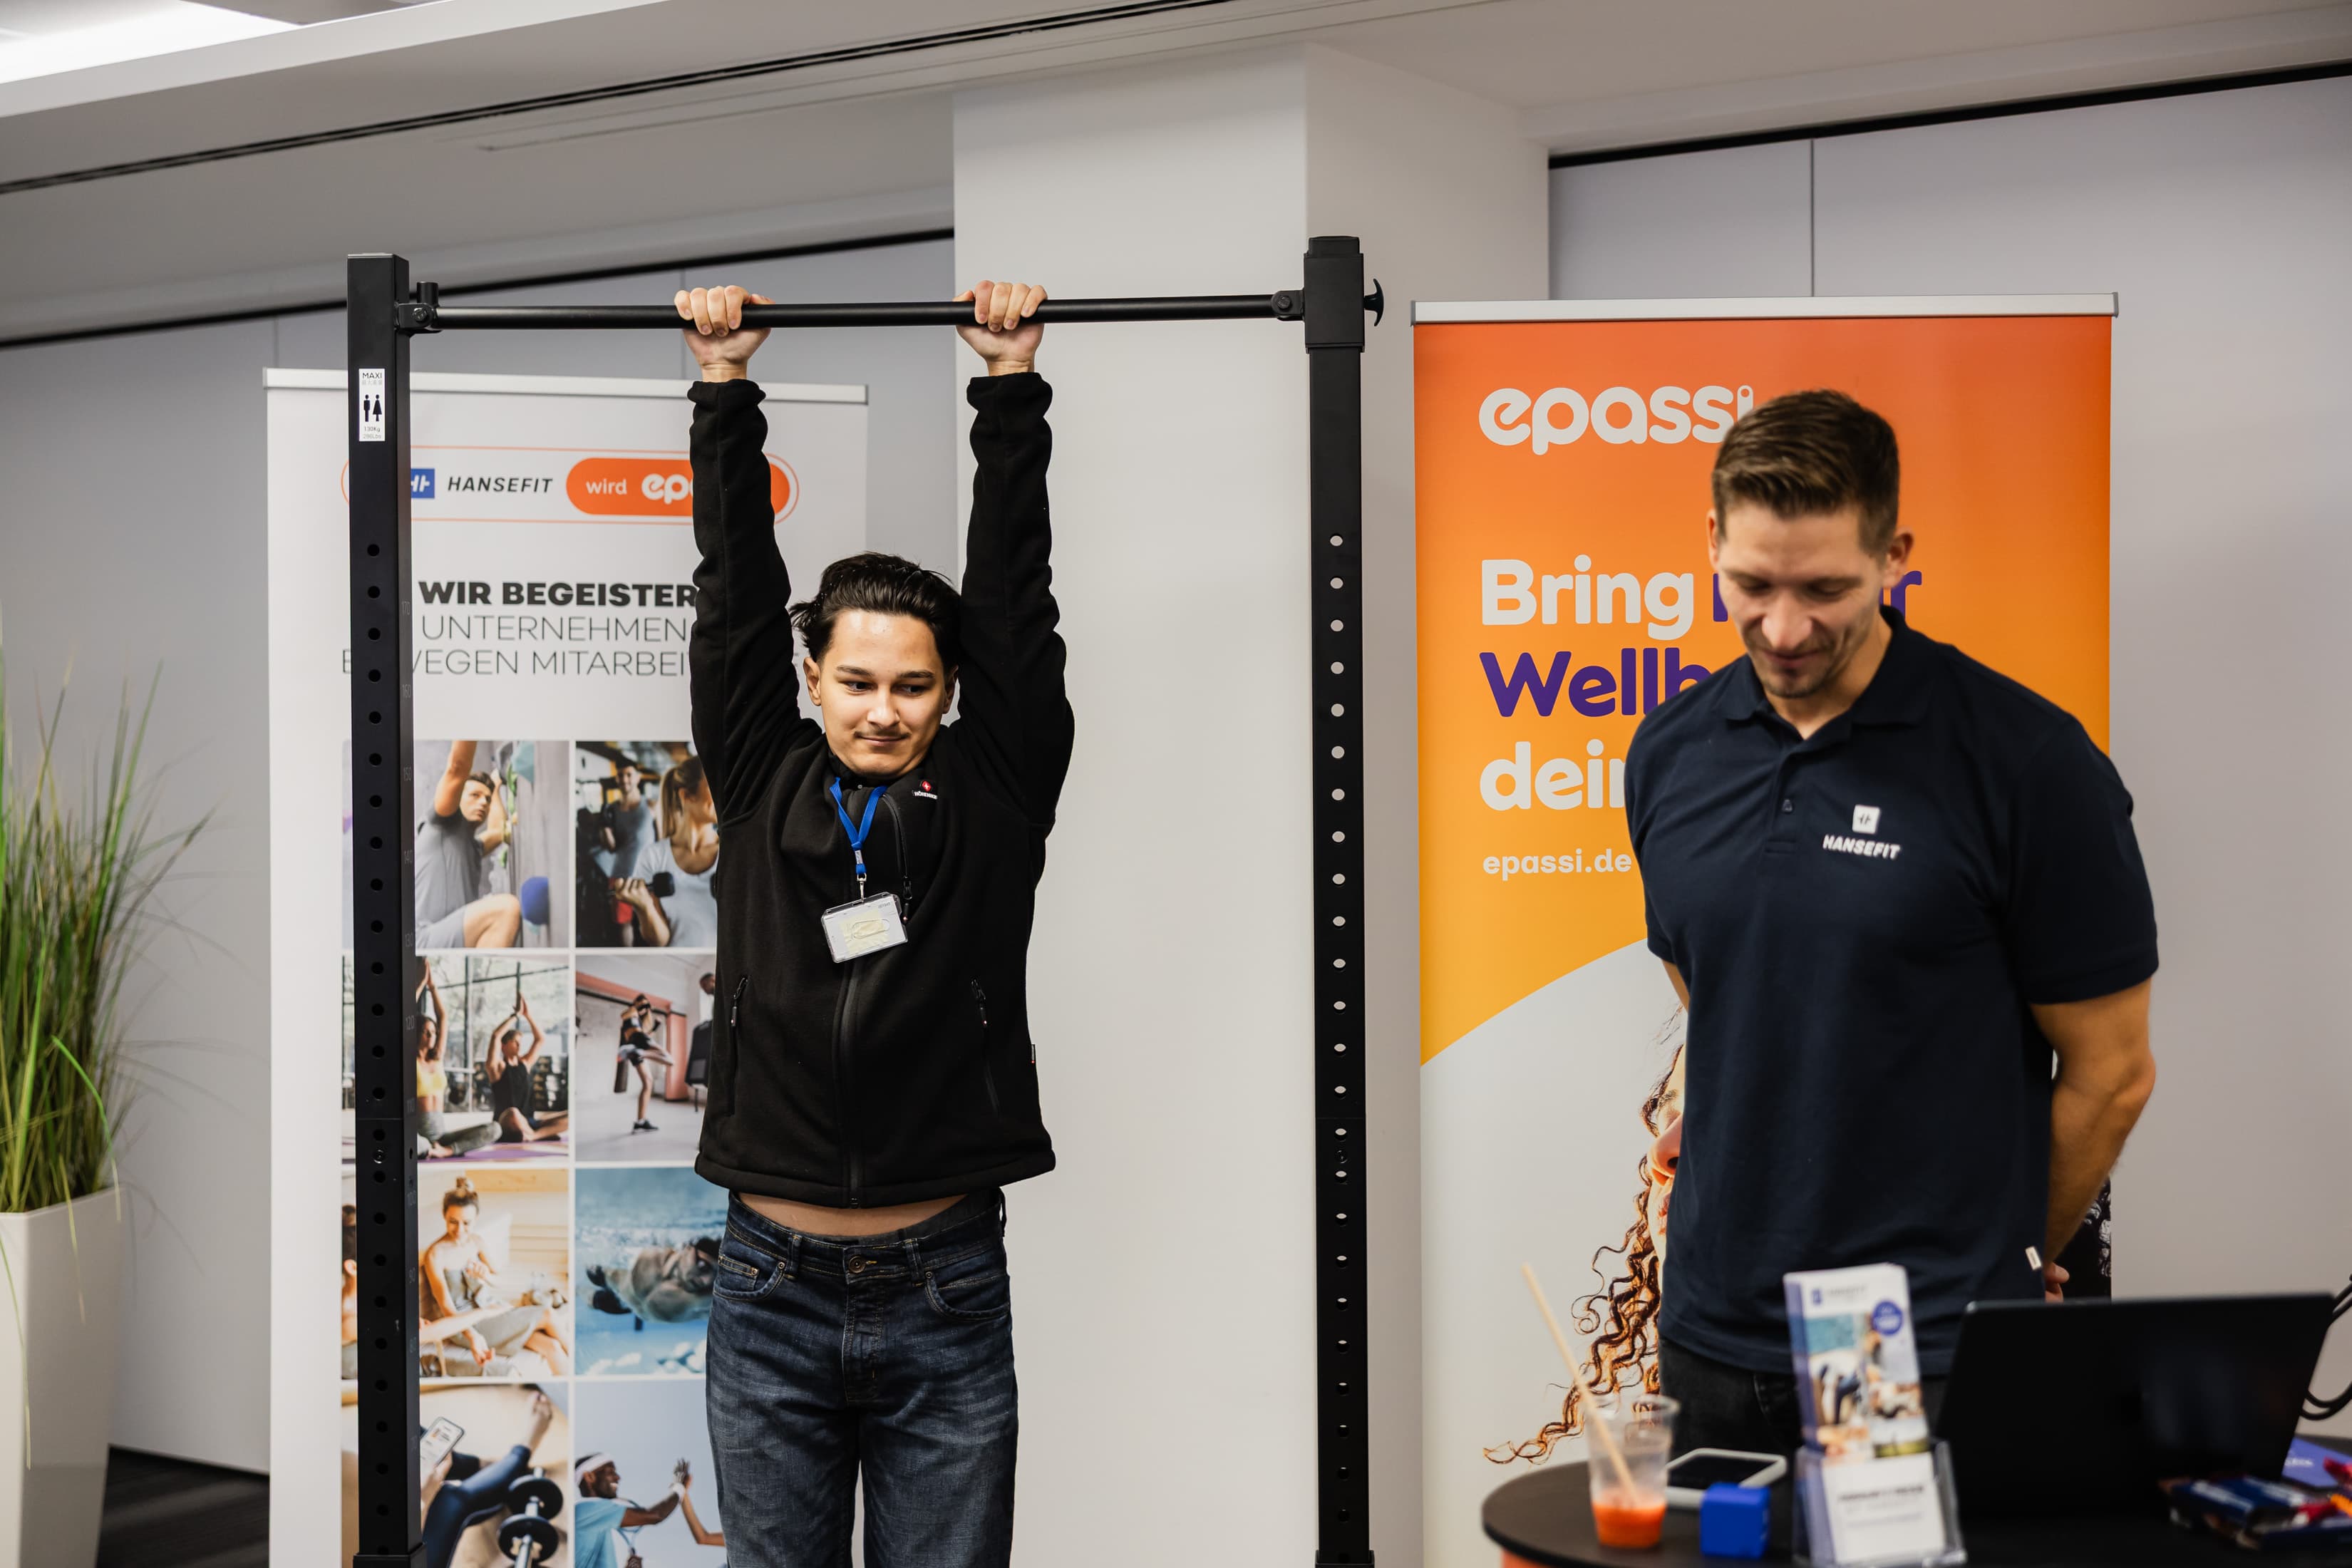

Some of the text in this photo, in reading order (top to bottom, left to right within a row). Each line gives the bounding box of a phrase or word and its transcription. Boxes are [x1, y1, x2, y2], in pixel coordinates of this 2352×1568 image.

[1479, 385, 1753, 455] epassi
[448, 476, 553, 493] HANSEFIT
[586, 473, 693, 505] wird ep
[418, 581, 698, 607] WIR BEGEISTER
[1481, 555, 1695, 641] Bring
[423, 615, 686, 642] UNTERNEHMEN
[532, 651, 689, 676] MITARBEI
[1479, 647, 1712, 717] Wellb
[1822, 835, 1902, 860] HANSEFIT
[1482, 848, 1632, 882] epassi.de
